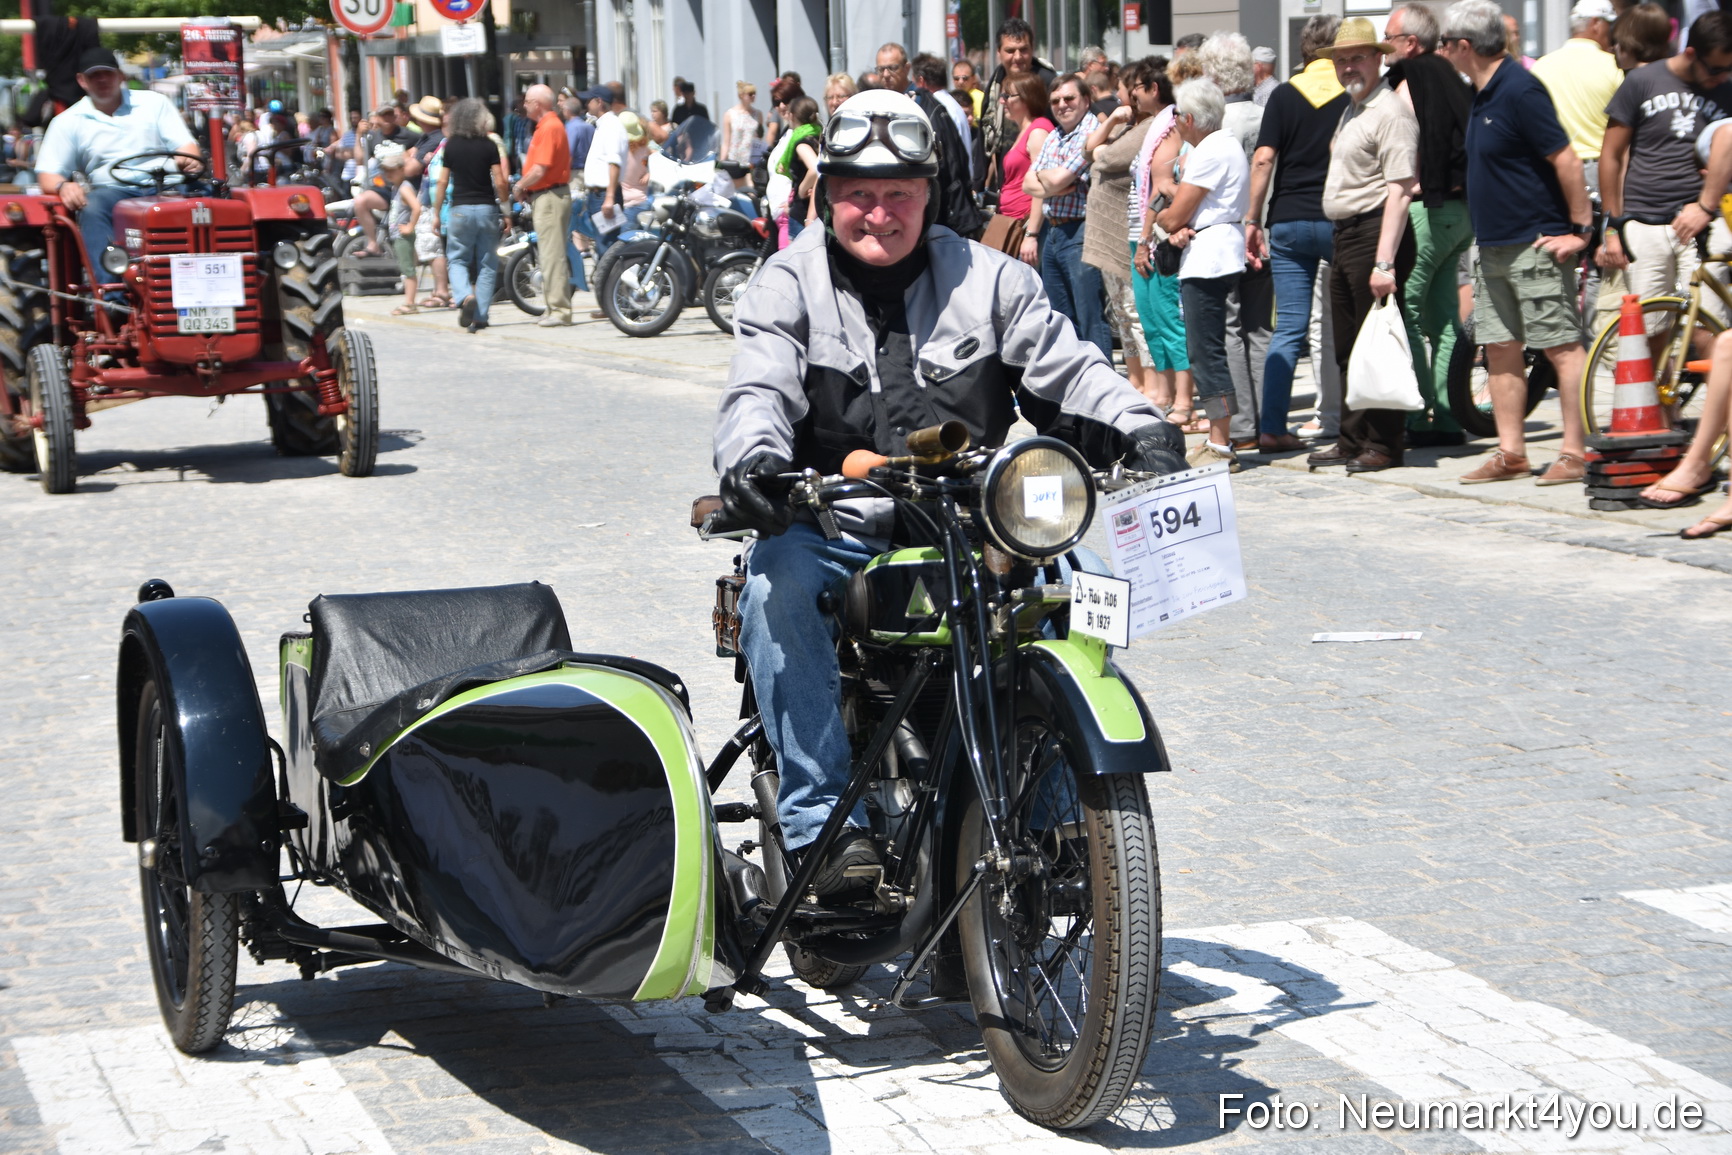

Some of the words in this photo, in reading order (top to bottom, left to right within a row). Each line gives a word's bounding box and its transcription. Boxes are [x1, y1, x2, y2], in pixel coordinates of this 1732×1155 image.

[204, 264, 226, 274] 551
[189, 307, 207, 316] NM
[183, 318, 200, 330] QQ
[203, 318, 228, 330] 345
[1150, 501, 1202, 539] 594
